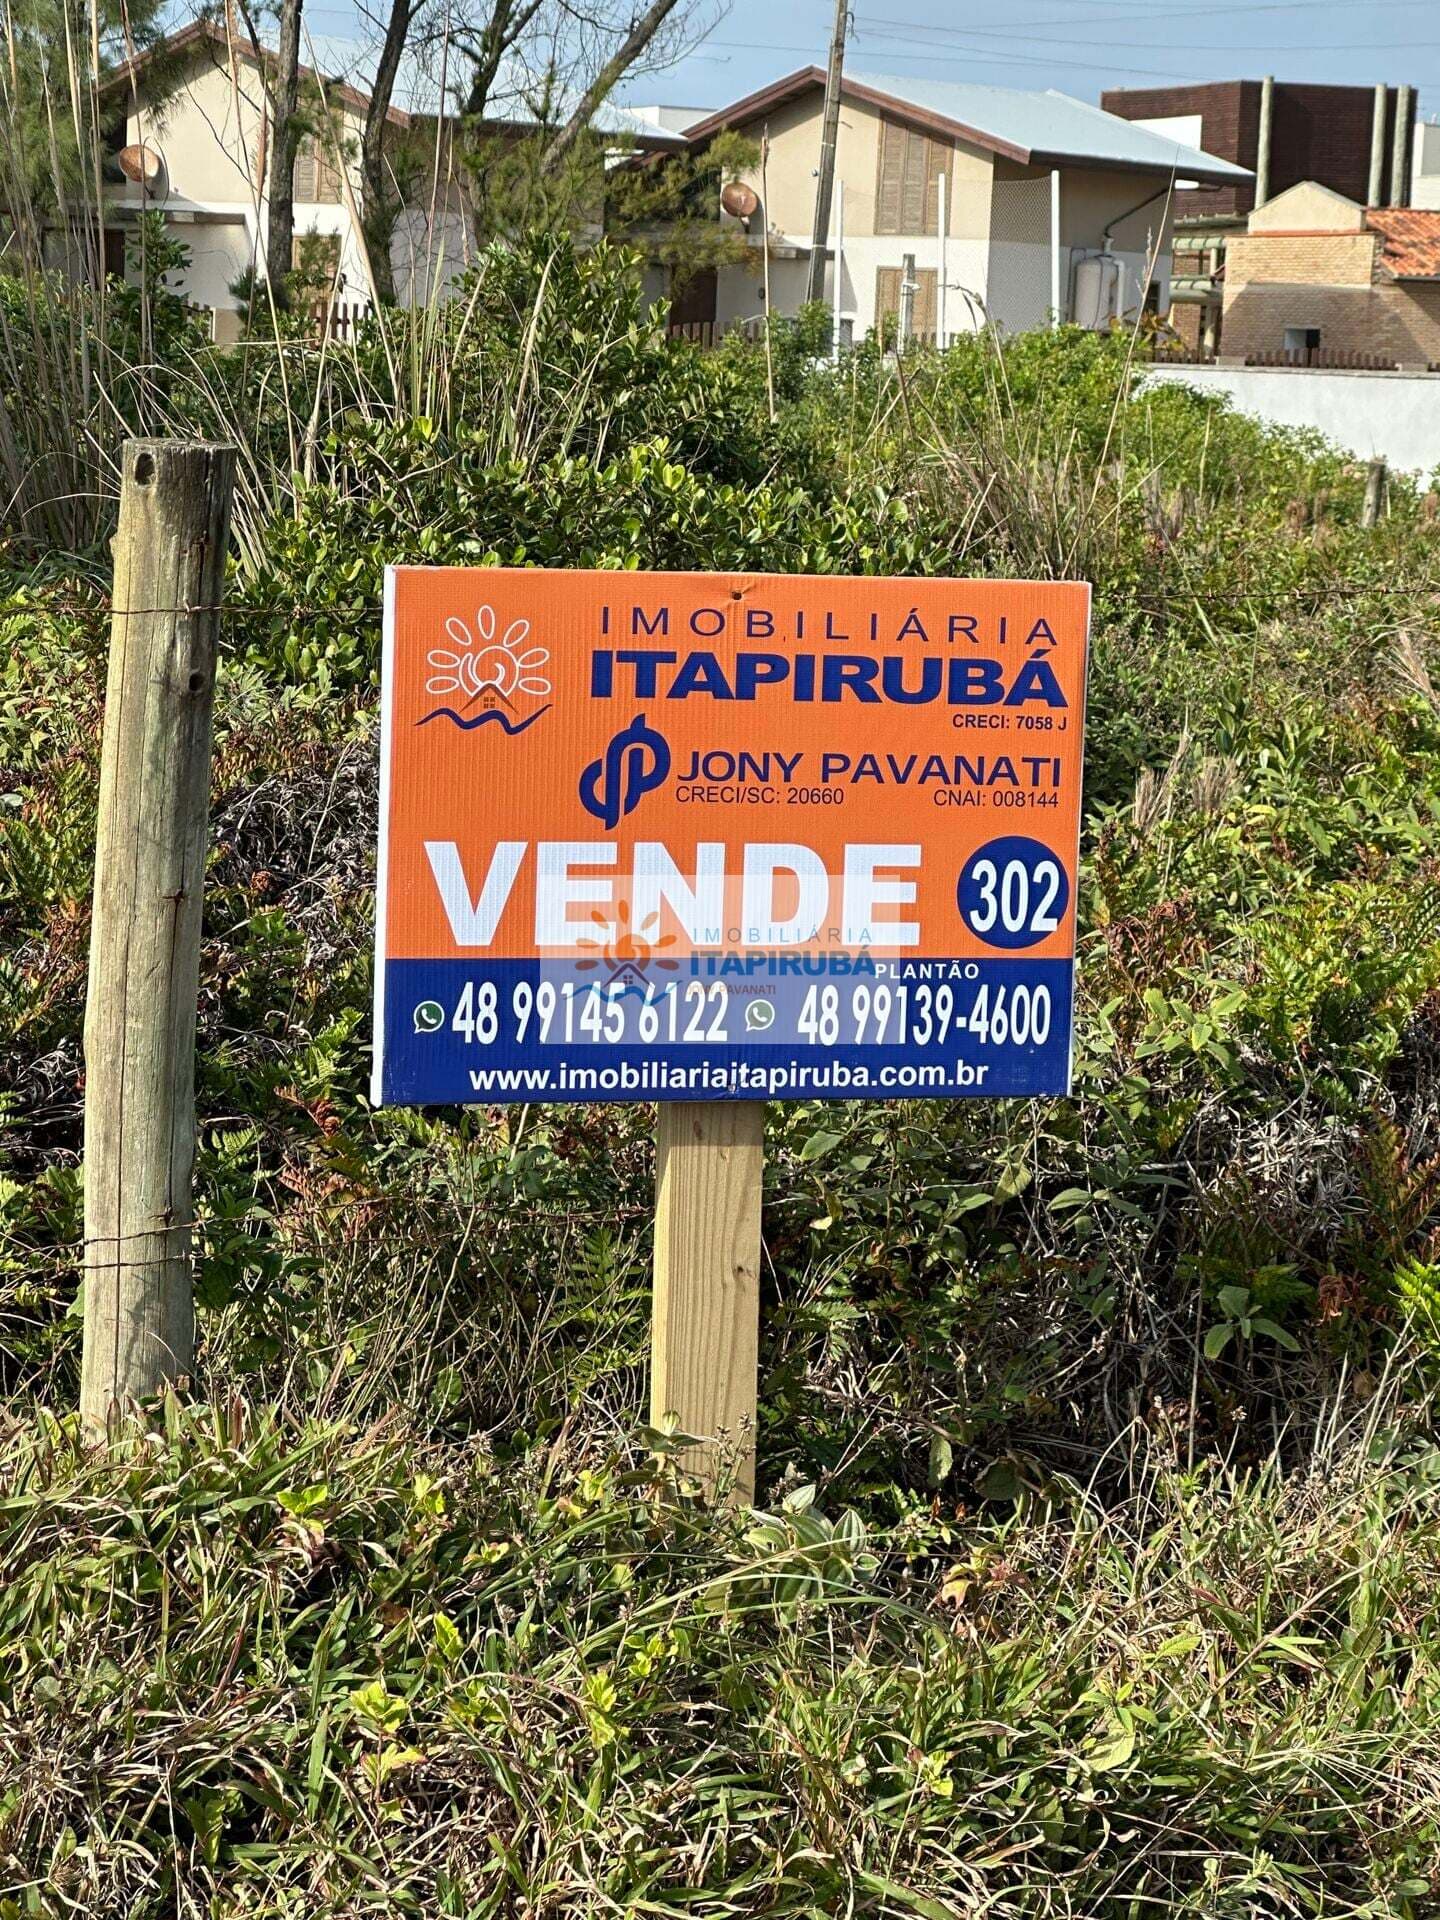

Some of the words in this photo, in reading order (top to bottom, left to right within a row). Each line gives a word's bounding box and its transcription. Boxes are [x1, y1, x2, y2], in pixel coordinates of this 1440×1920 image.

[601, 606, 1058, 646] IMOBILIÁRIA
[591, 648, 1068, 708] ITAPIRUBÁ
[952, 713, 1010, 730] CRECI:
[1016, 715, 1053, 731] 7058
[1058, 716, 1067, 731] J
[677, 751, 803, 782] JONY
[822, 753, 1061, 788] PAVANATI
[676, 786, 780, 804] CRECI/SC:
[787, 787, 844, 805] 20660
[934, 789, 986, 807] CNAI:
[993, 790, 1059, 808] 008144
[424, 841, 921, 946] VENDE
[969, 859, 1060, 932] 302
[875, 960, 979, 979] PLANTÃO
[452, 981, 498, 1045] 48
[513, 981, 625, 1044] 99145
[639, 981, 728, 1042] 6122
[798, 984, 839, 1045] 48
[852, 984, 1051, 1045] 99139-4600
[469, 1060, 989, 1094] www.imobiliariaitapiruba.com.br
